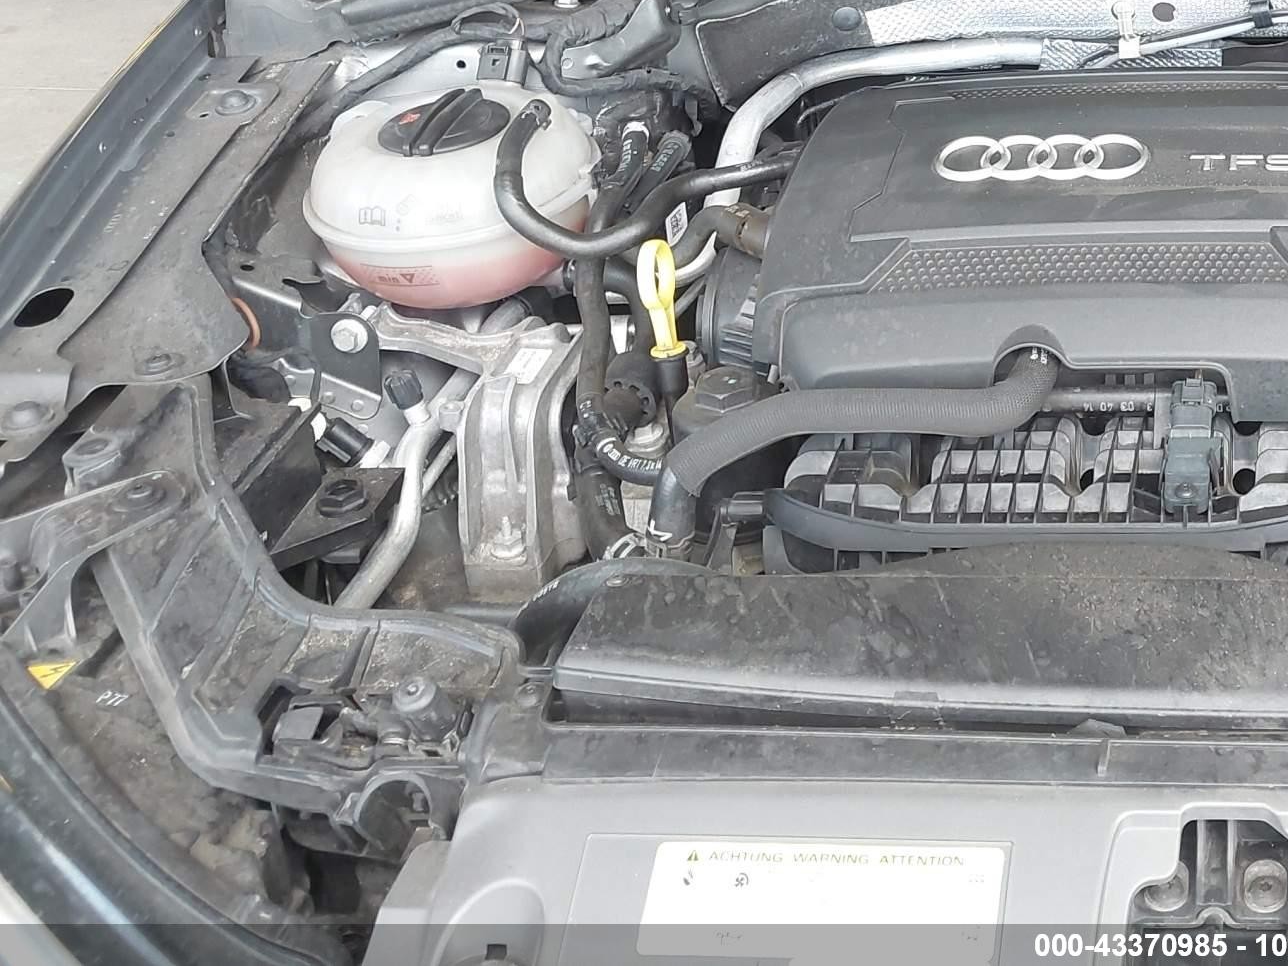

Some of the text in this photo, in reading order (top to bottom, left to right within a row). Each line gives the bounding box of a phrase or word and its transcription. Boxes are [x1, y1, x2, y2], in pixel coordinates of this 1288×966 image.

[709, 850, 964, 866] ACHTUNG WARNING ATTENTION
